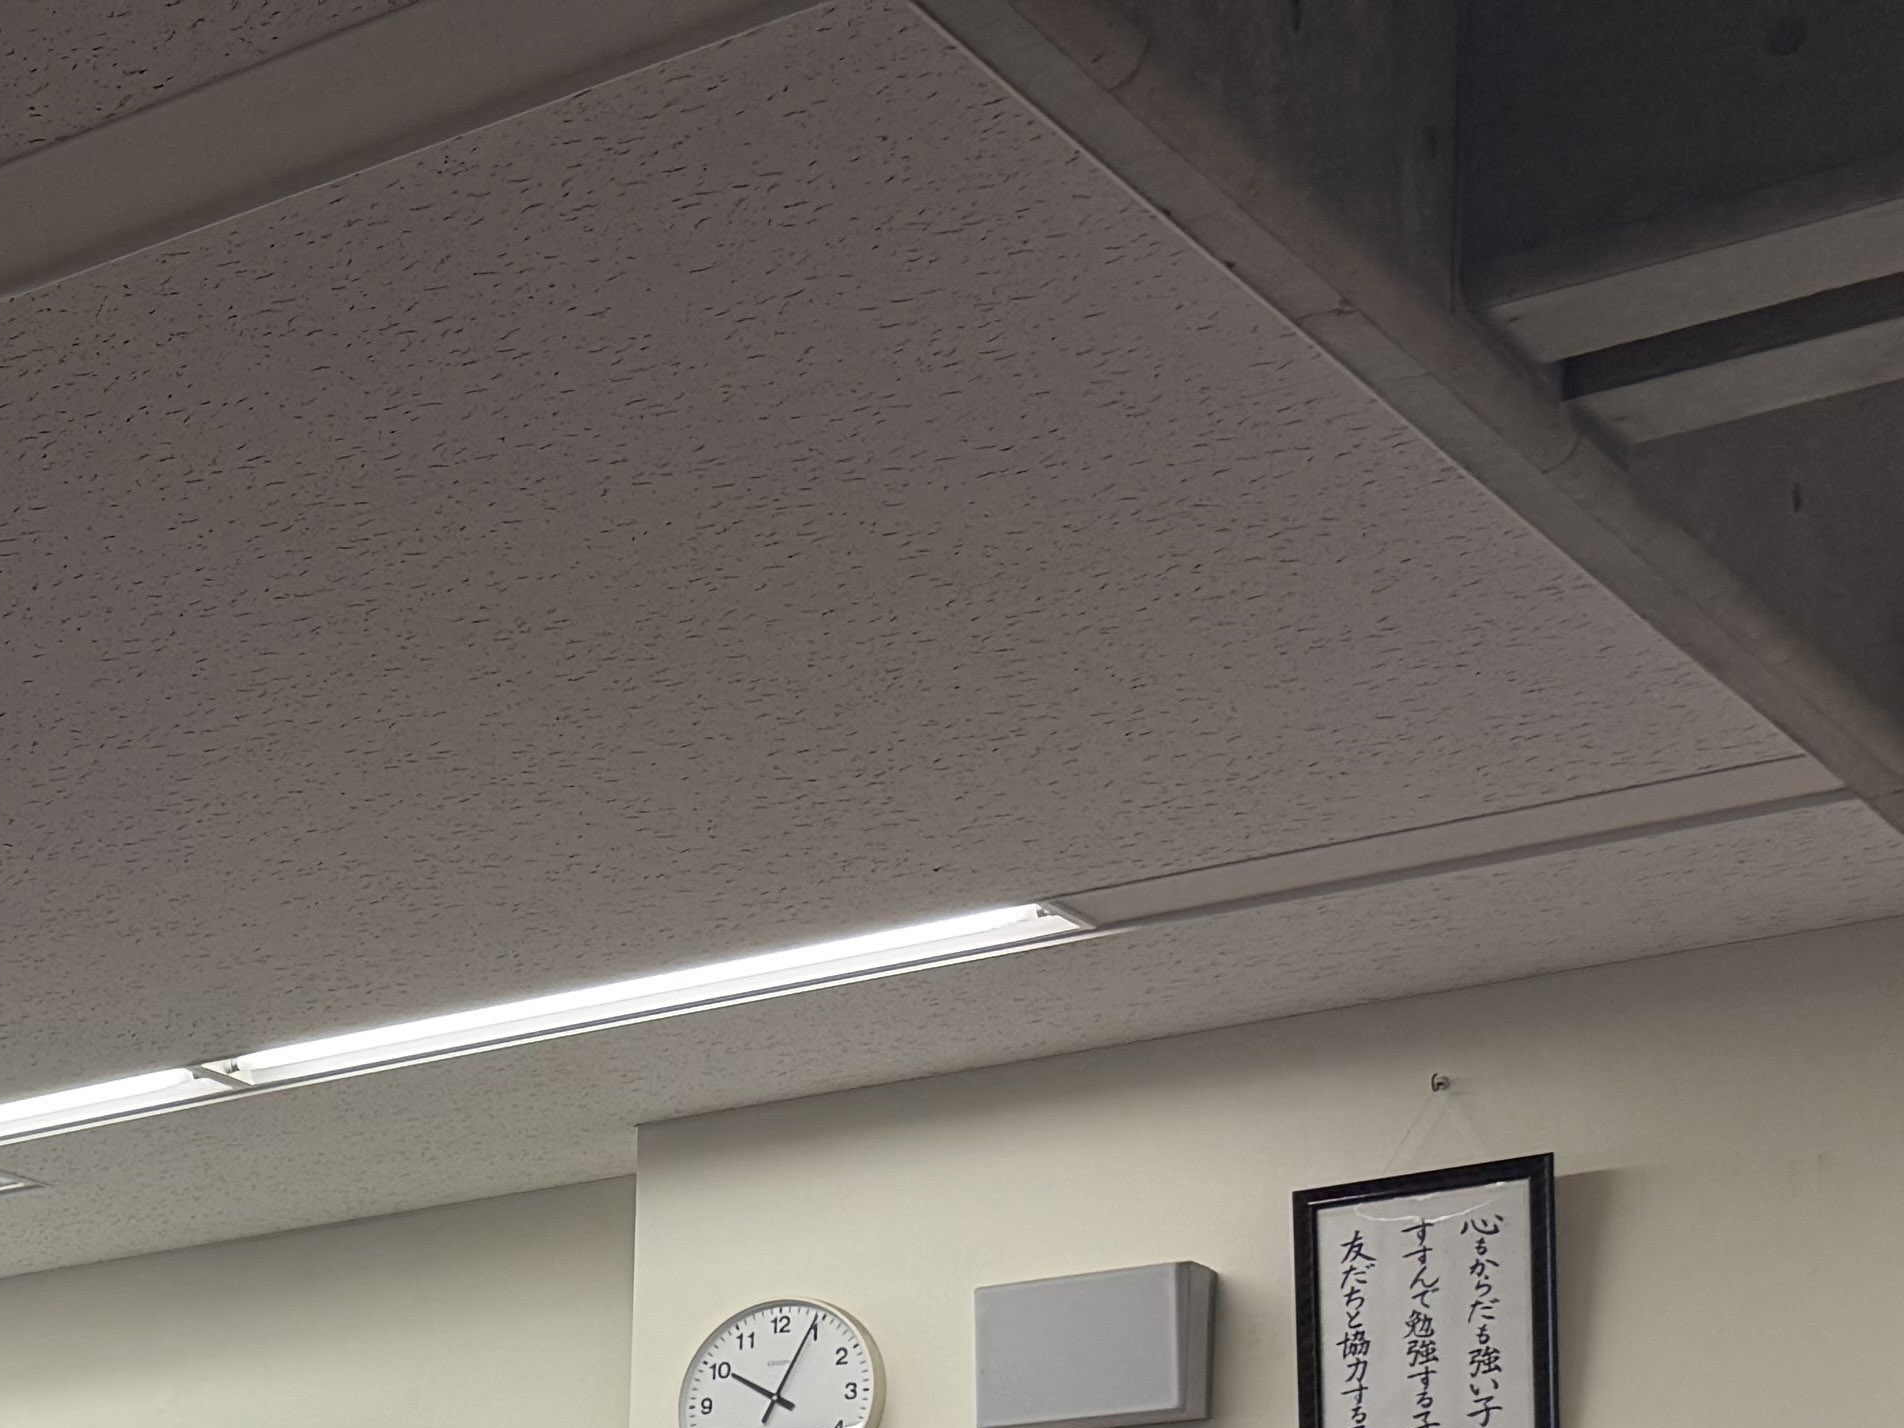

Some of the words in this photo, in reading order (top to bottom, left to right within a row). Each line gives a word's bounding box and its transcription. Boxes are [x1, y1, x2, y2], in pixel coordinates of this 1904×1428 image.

[771, 1316, 791, 1333] 12
[1460, 1214, 1504, 1427] 心もからだも強い子
[736, 1332, 755, 1350] 11
[835, 1347, 848, 1365] 2
[709, 1362, 731, 1380] 10
[845, 1382, 857, 1400] 3
[701, 1398, 713, 1414] 9
